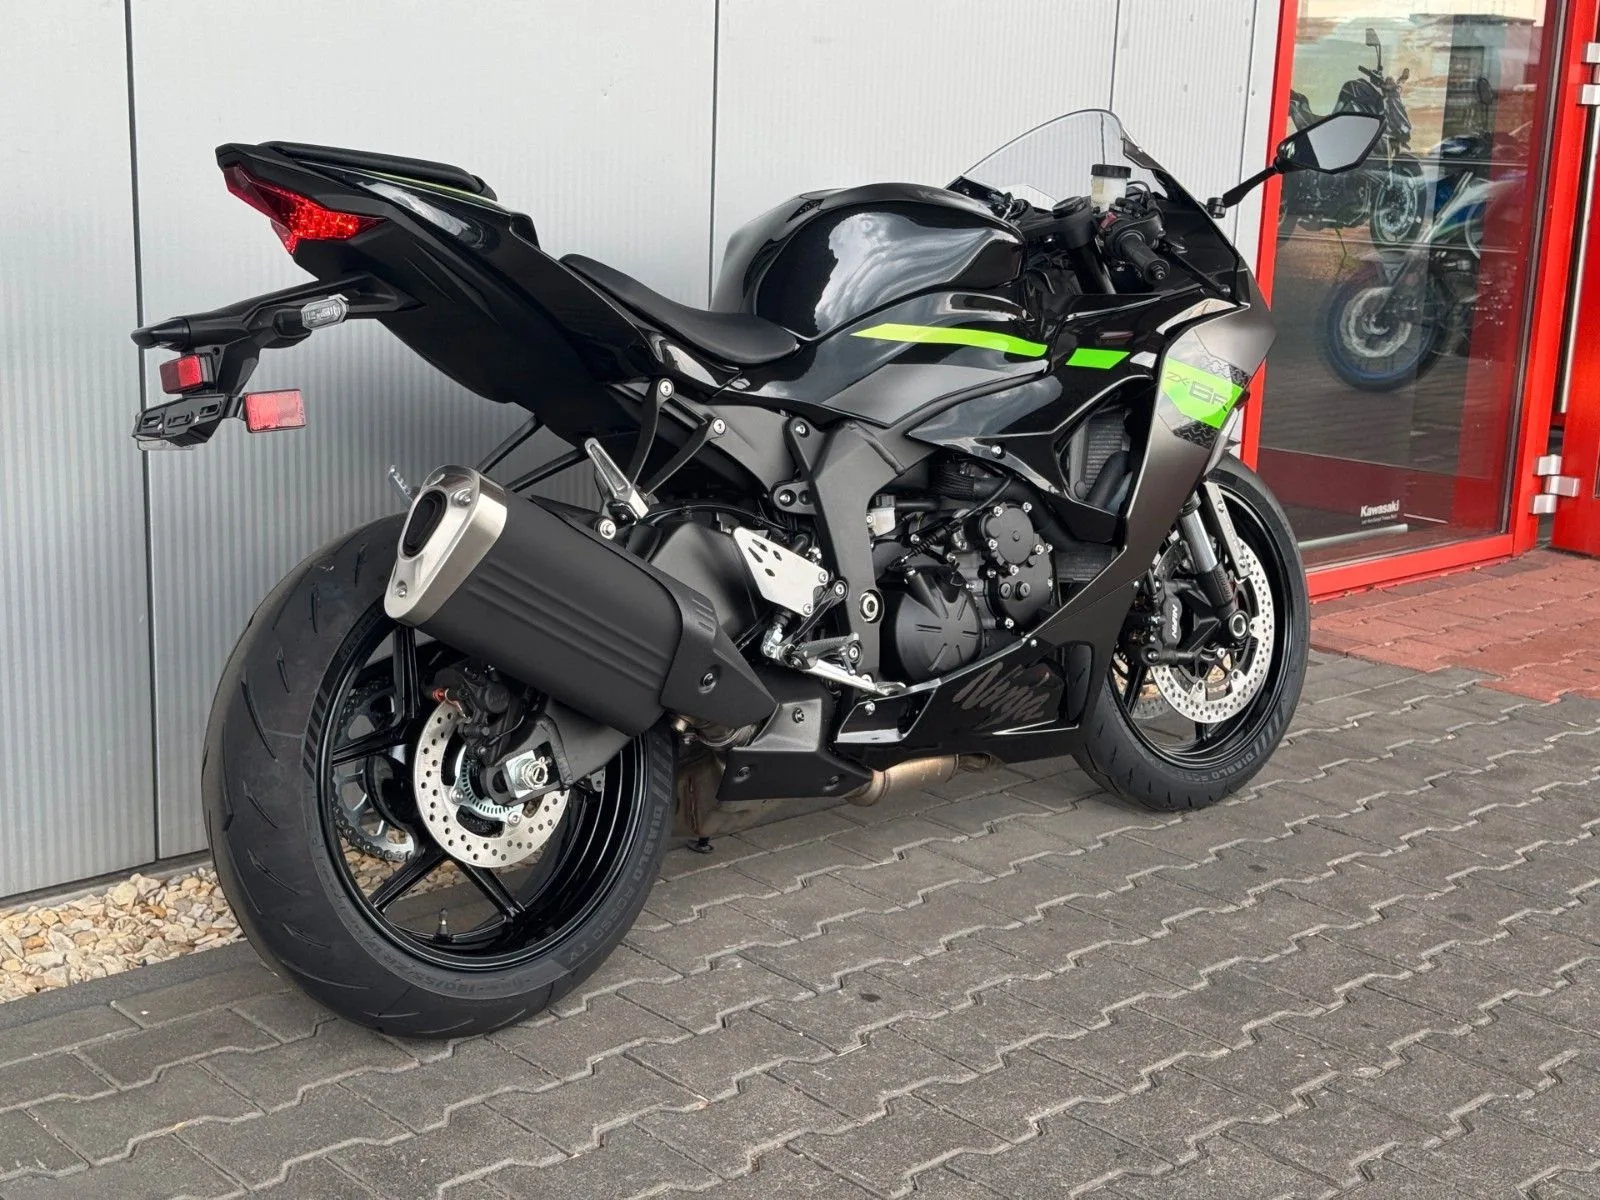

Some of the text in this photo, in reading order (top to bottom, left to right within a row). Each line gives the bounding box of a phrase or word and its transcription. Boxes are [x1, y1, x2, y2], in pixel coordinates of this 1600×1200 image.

[1360, 499, 1400, 518] Kawasaki
[952, 661, 1050, 730] Ninja
[1211, 751, 1256, 780] DIABLO
[632, 805, 664, 881] DIABLO
